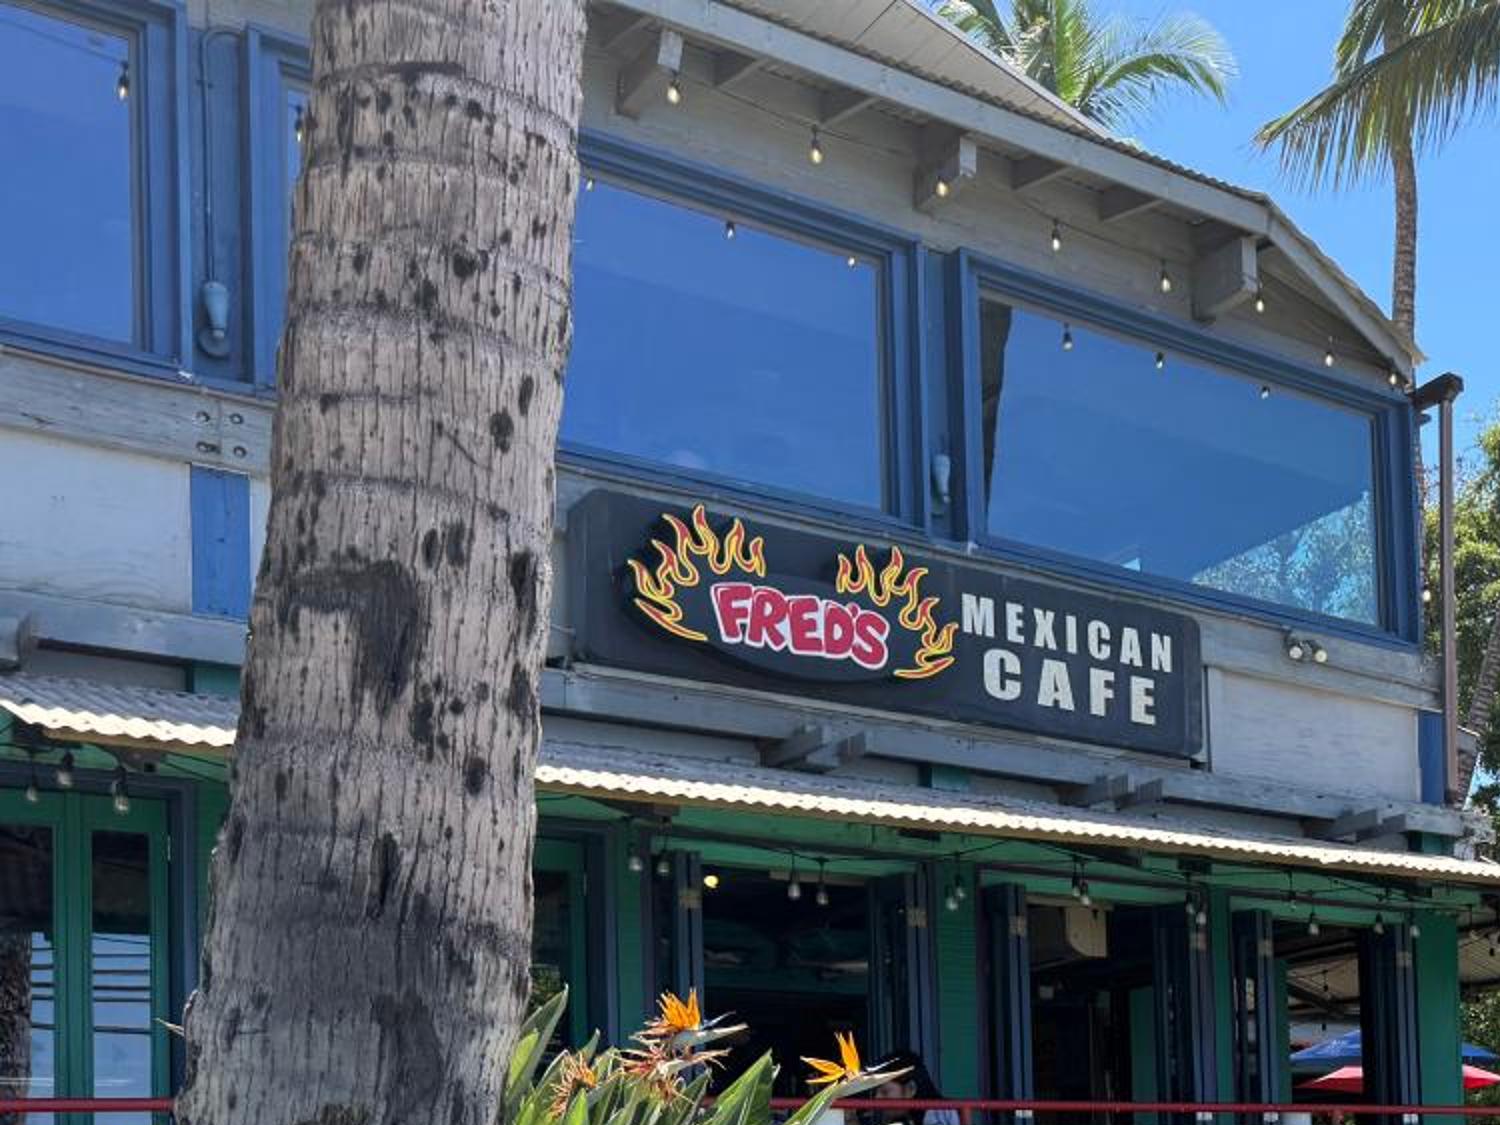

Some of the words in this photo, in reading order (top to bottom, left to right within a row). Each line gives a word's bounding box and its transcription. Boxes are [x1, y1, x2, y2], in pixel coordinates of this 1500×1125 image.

[711, 583, 889, 668] FRED'S
[962, 594, 1174, 673] MEXICAN
[984, 649, 1156, 725] CAFE
